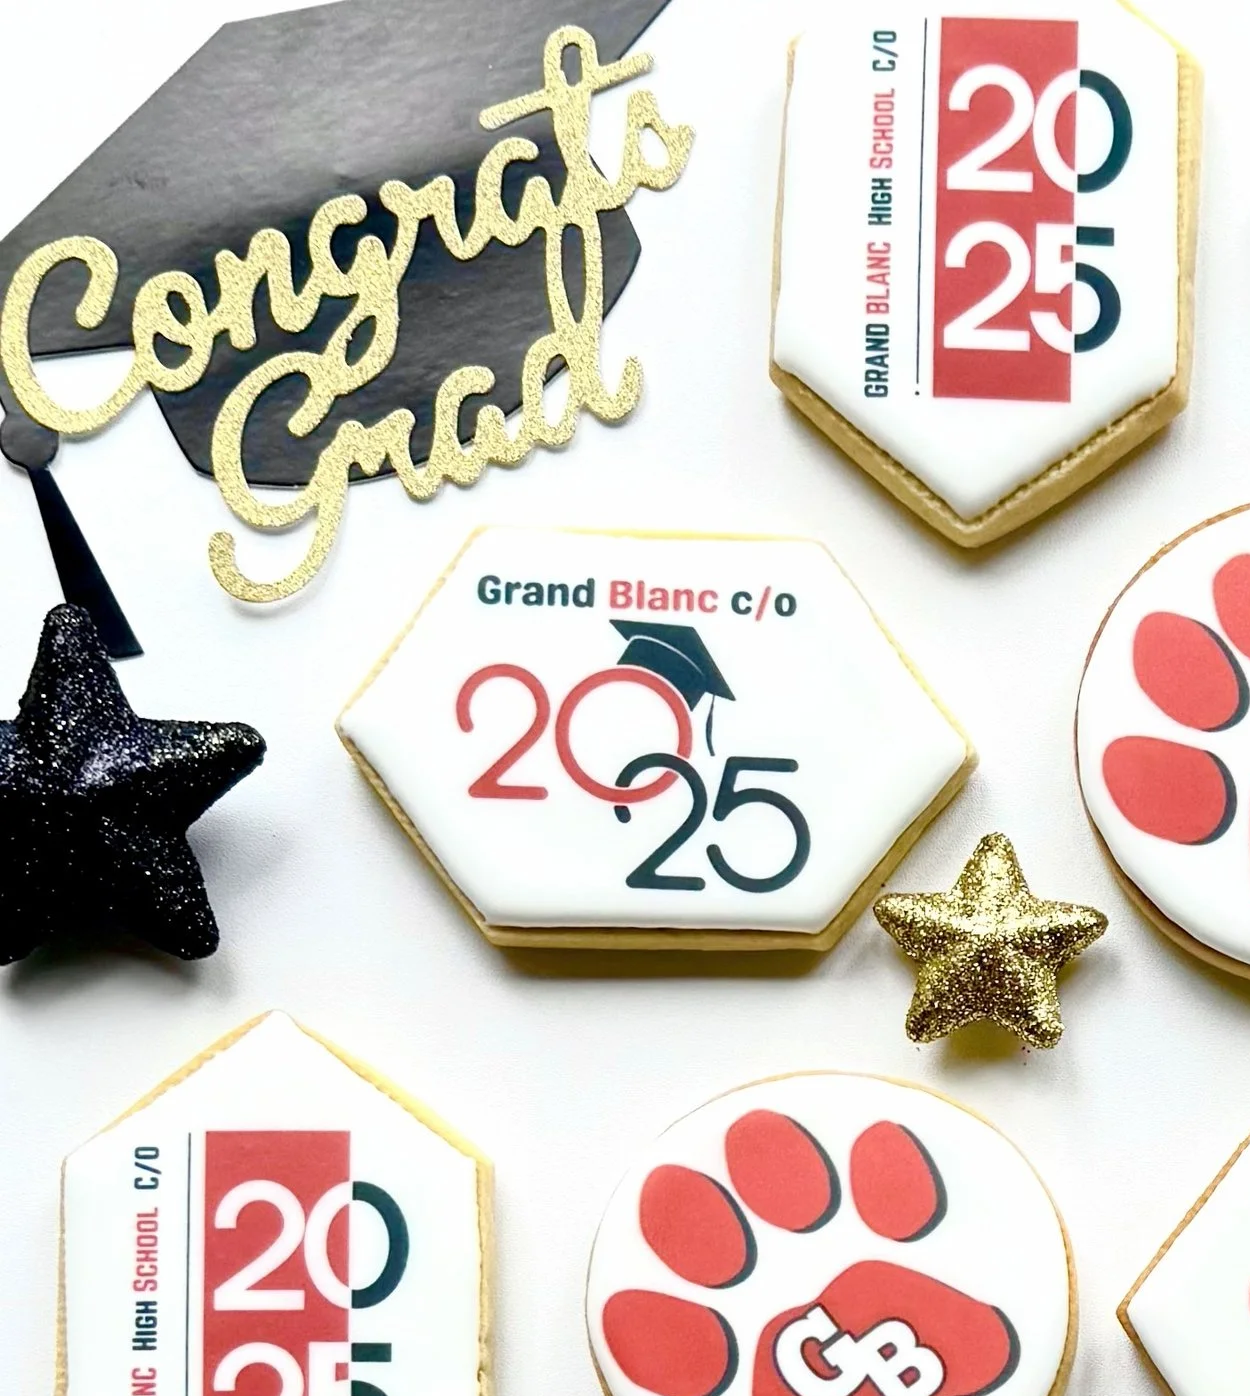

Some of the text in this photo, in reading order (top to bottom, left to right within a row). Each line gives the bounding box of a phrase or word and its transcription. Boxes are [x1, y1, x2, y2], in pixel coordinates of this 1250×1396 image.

[0, 25, 696, 436] Congrats
[863, 30, 899, 399] GRAND BLANC HIGH SCHOOL C/O
[208, 216, 644, 602] Grad
[476, 574, 798, 621] Grand Blanc c/o
[133, 1146, 162, 1191] C/O
[132, 1207, 159, 1292] SCHOOL
[131, 1300, 158, 1352] HIGH
